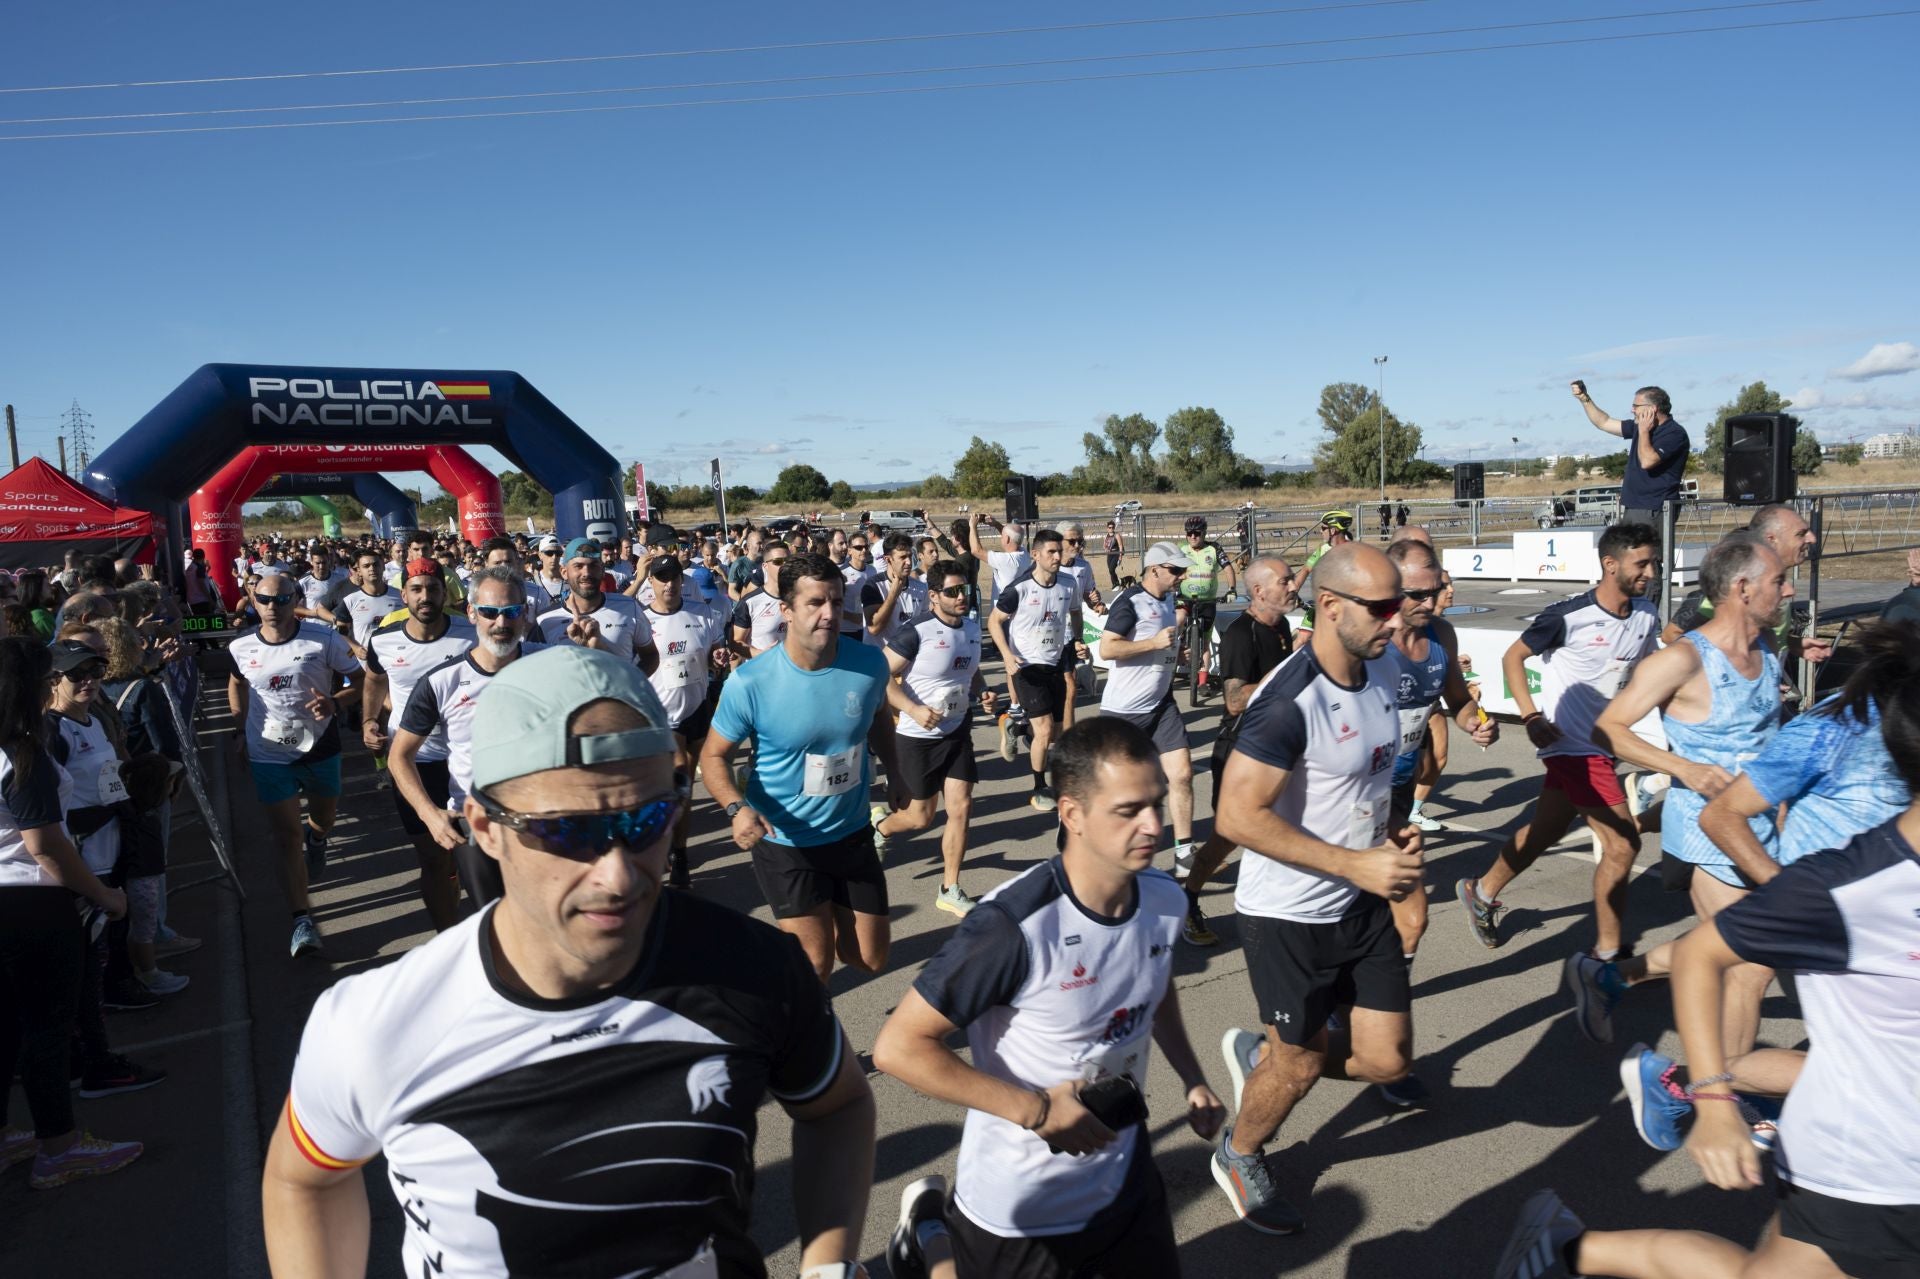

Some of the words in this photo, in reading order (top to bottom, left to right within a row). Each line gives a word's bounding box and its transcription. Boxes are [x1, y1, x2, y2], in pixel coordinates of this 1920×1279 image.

[252, 402, 492, 426] NACIONAL
[317, 455, 383, 464] sportssantander.es
[4, 491, 59, 501] Sports
[582, 499, 616, 521] RUTA
[35, 523, 70, 534] Sports
[1547, 538, 1556, 557] 1
[1472, 554, 1483, 572] 2
[276, 736, 298, 745] 266
[826, 772, 850, 786] 182
